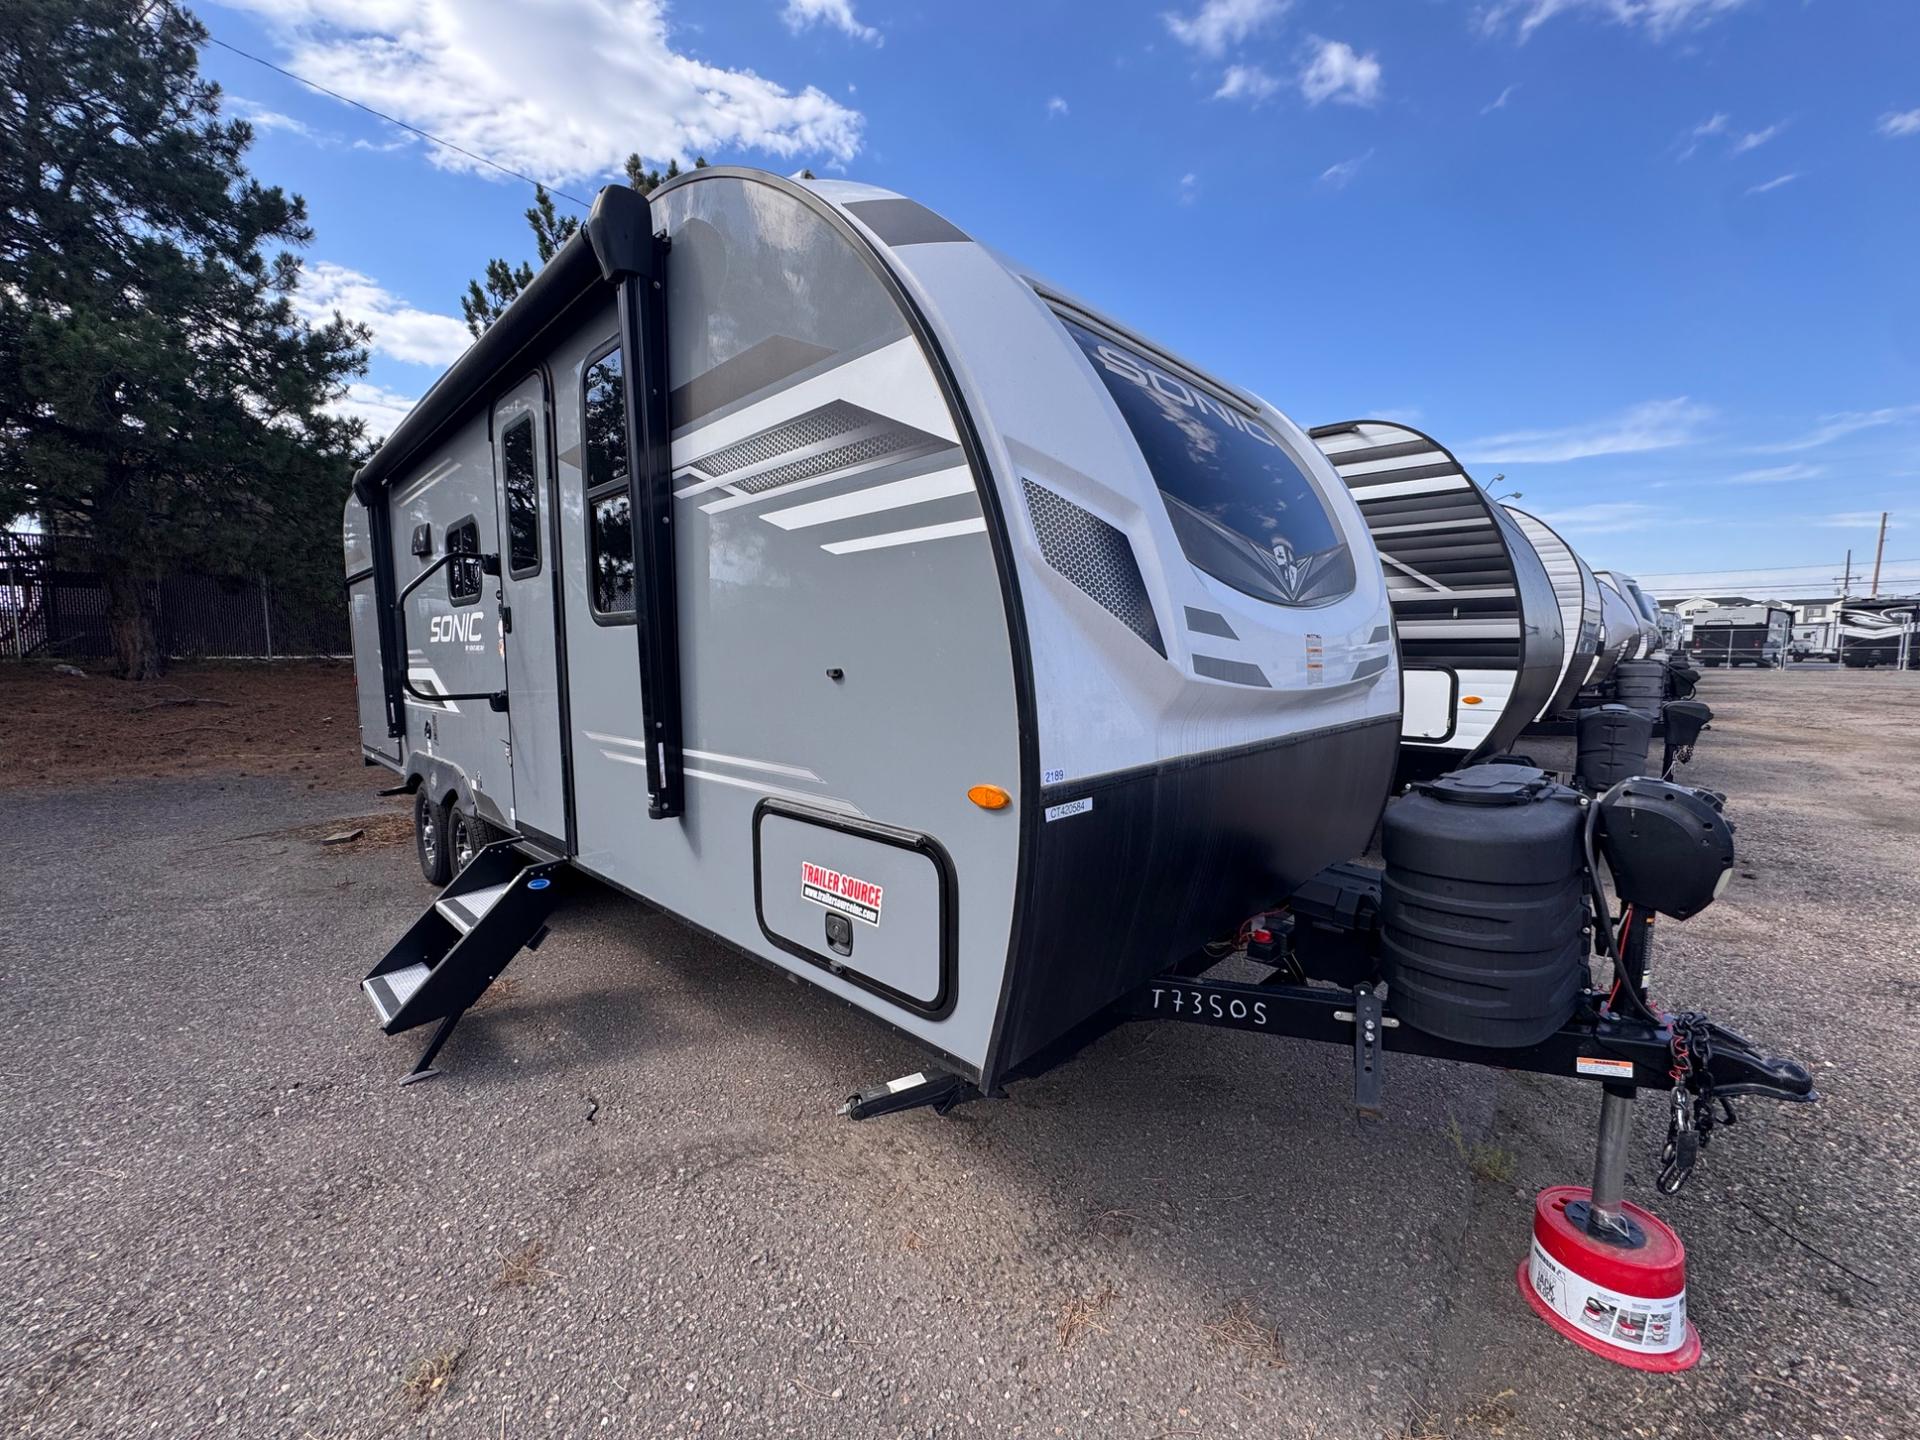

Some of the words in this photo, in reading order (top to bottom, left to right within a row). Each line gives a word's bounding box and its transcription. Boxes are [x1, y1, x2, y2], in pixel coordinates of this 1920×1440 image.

[1097, 345, 1275, 447] SONIC
[430, 611, 484, 643] SONIC
[1045, 769, 1064, 783] 2189
[1050, 801, 1085, 819] CT420584
[803, 863, 840, 893] TRAILER
[841, 876, 881, 907] SOURCE
